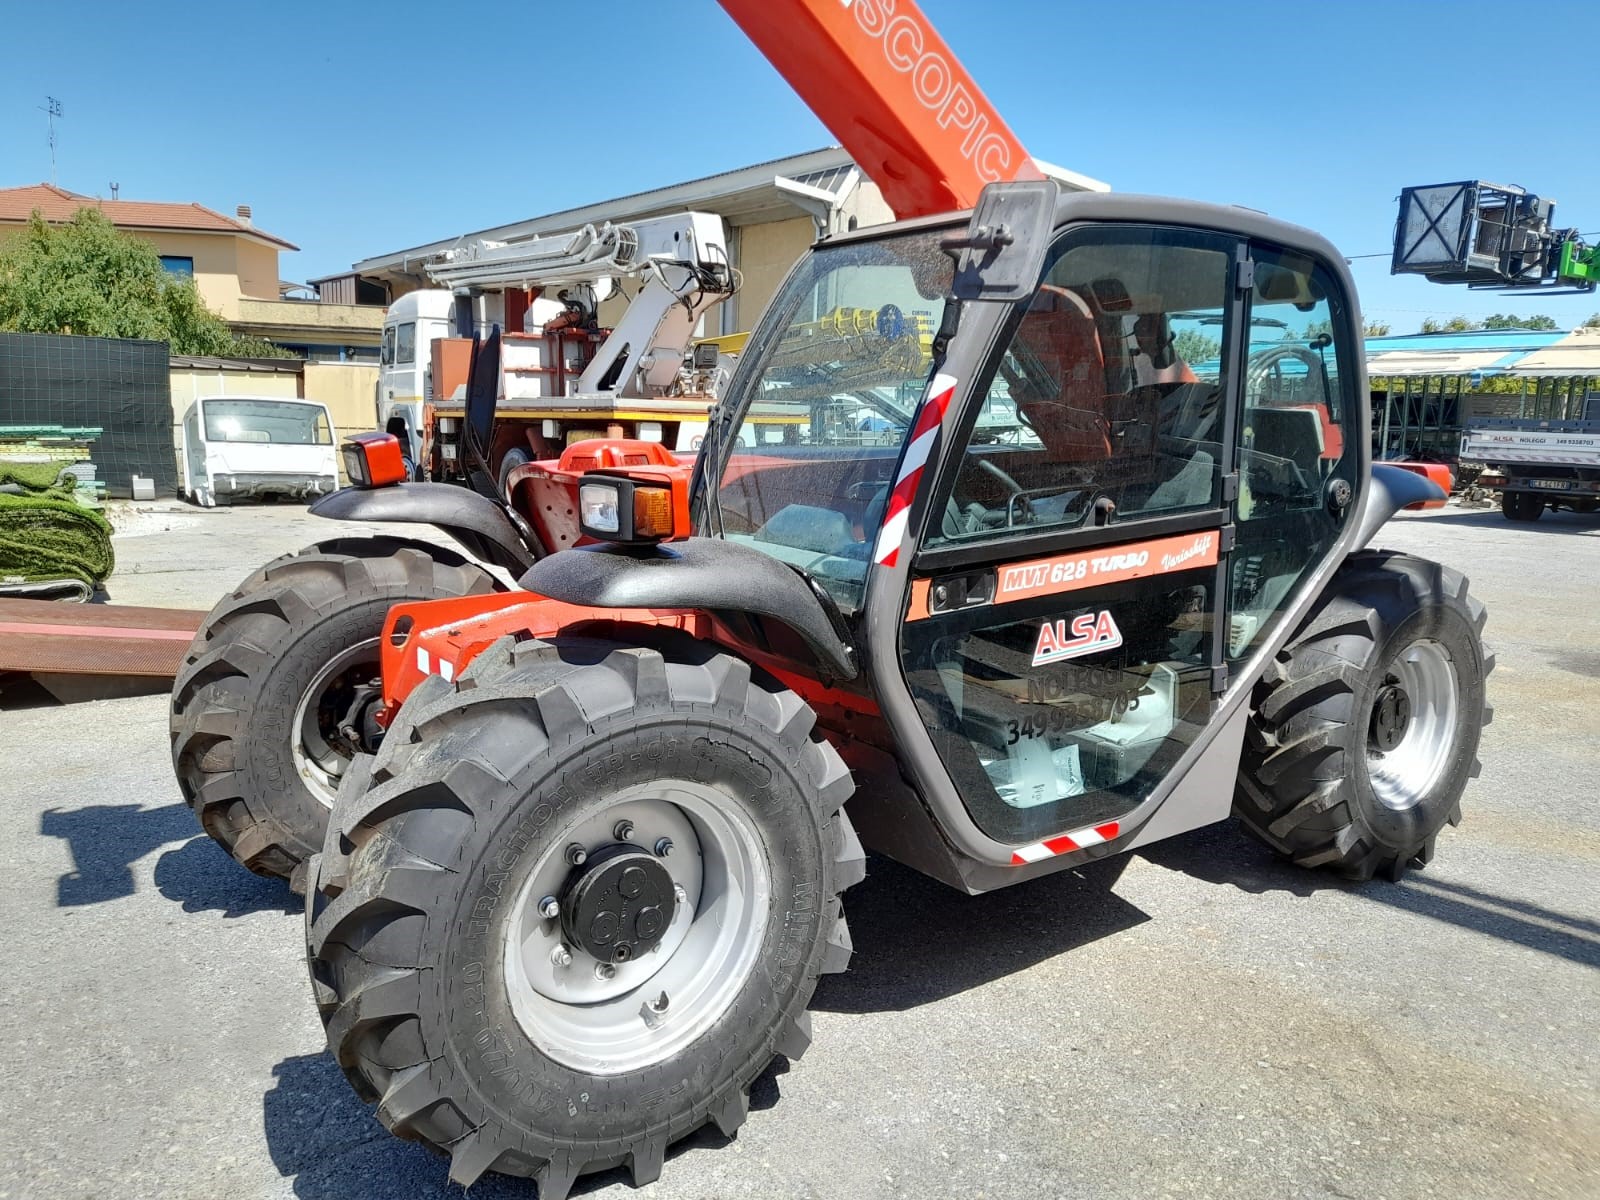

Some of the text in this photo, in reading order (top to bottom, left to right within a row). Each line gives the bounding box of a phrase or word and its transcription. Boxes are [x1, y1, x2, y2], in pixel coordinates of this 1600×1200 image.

[841, 0, 1010, 184] SCOPIC
[1003, 563, 1050, 592] MVT
[1051, 560, 1087, 583] 628
[1091, 550, 1149, 574] TURBO
[1034, 610, 1118, 656] ALSA
[467, 784, 572, 938] TRACTION
[772, 881, 814, 994] MITAS
